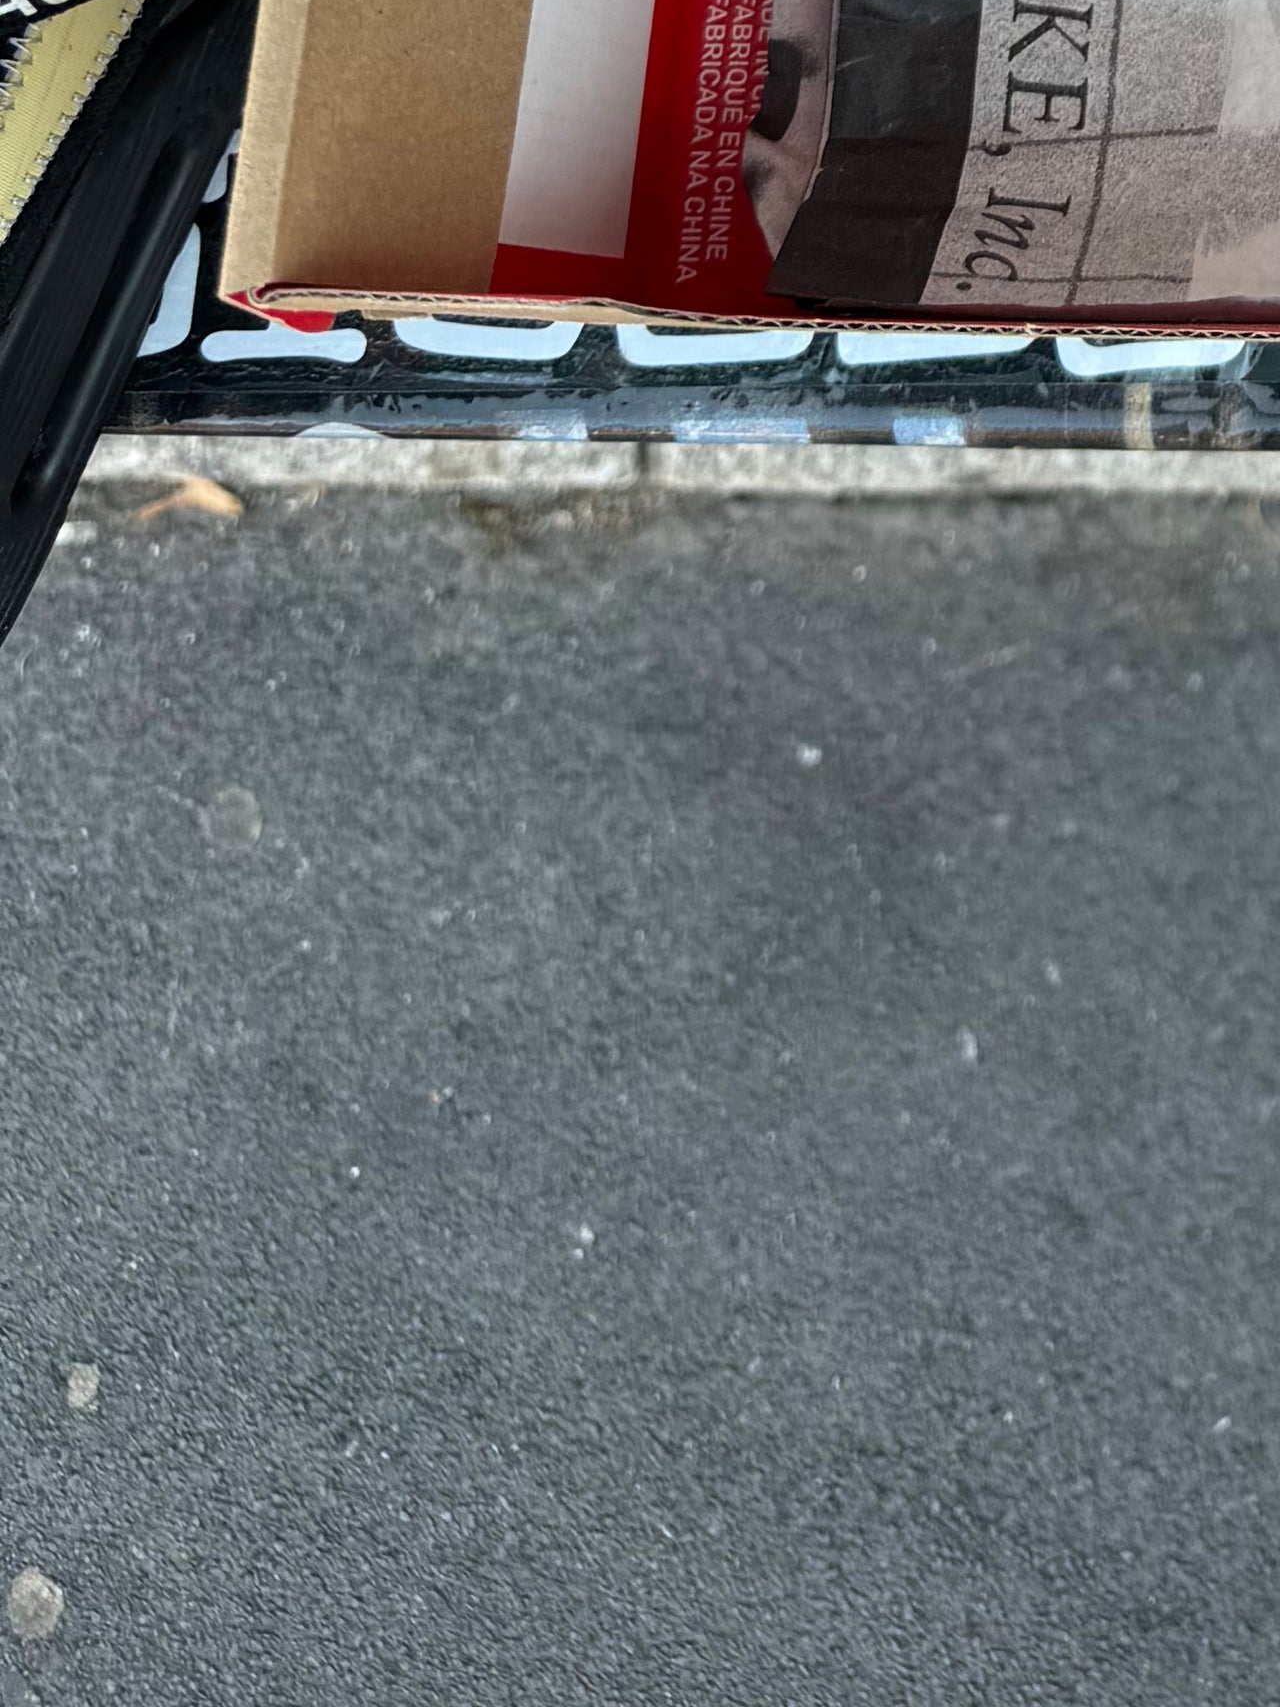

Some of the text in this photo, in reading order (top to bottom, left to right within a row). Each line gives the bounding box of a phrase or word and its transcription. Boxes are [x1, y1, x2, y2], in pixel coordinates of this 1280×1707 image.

[687, 149, 711, 191] NA
[716, 132, 742, 166] EN
[676, 196, 706, 284] CHINA
[706, 176, 735, 261] CHINE
[955, 186, 1072, 292] Inc.
